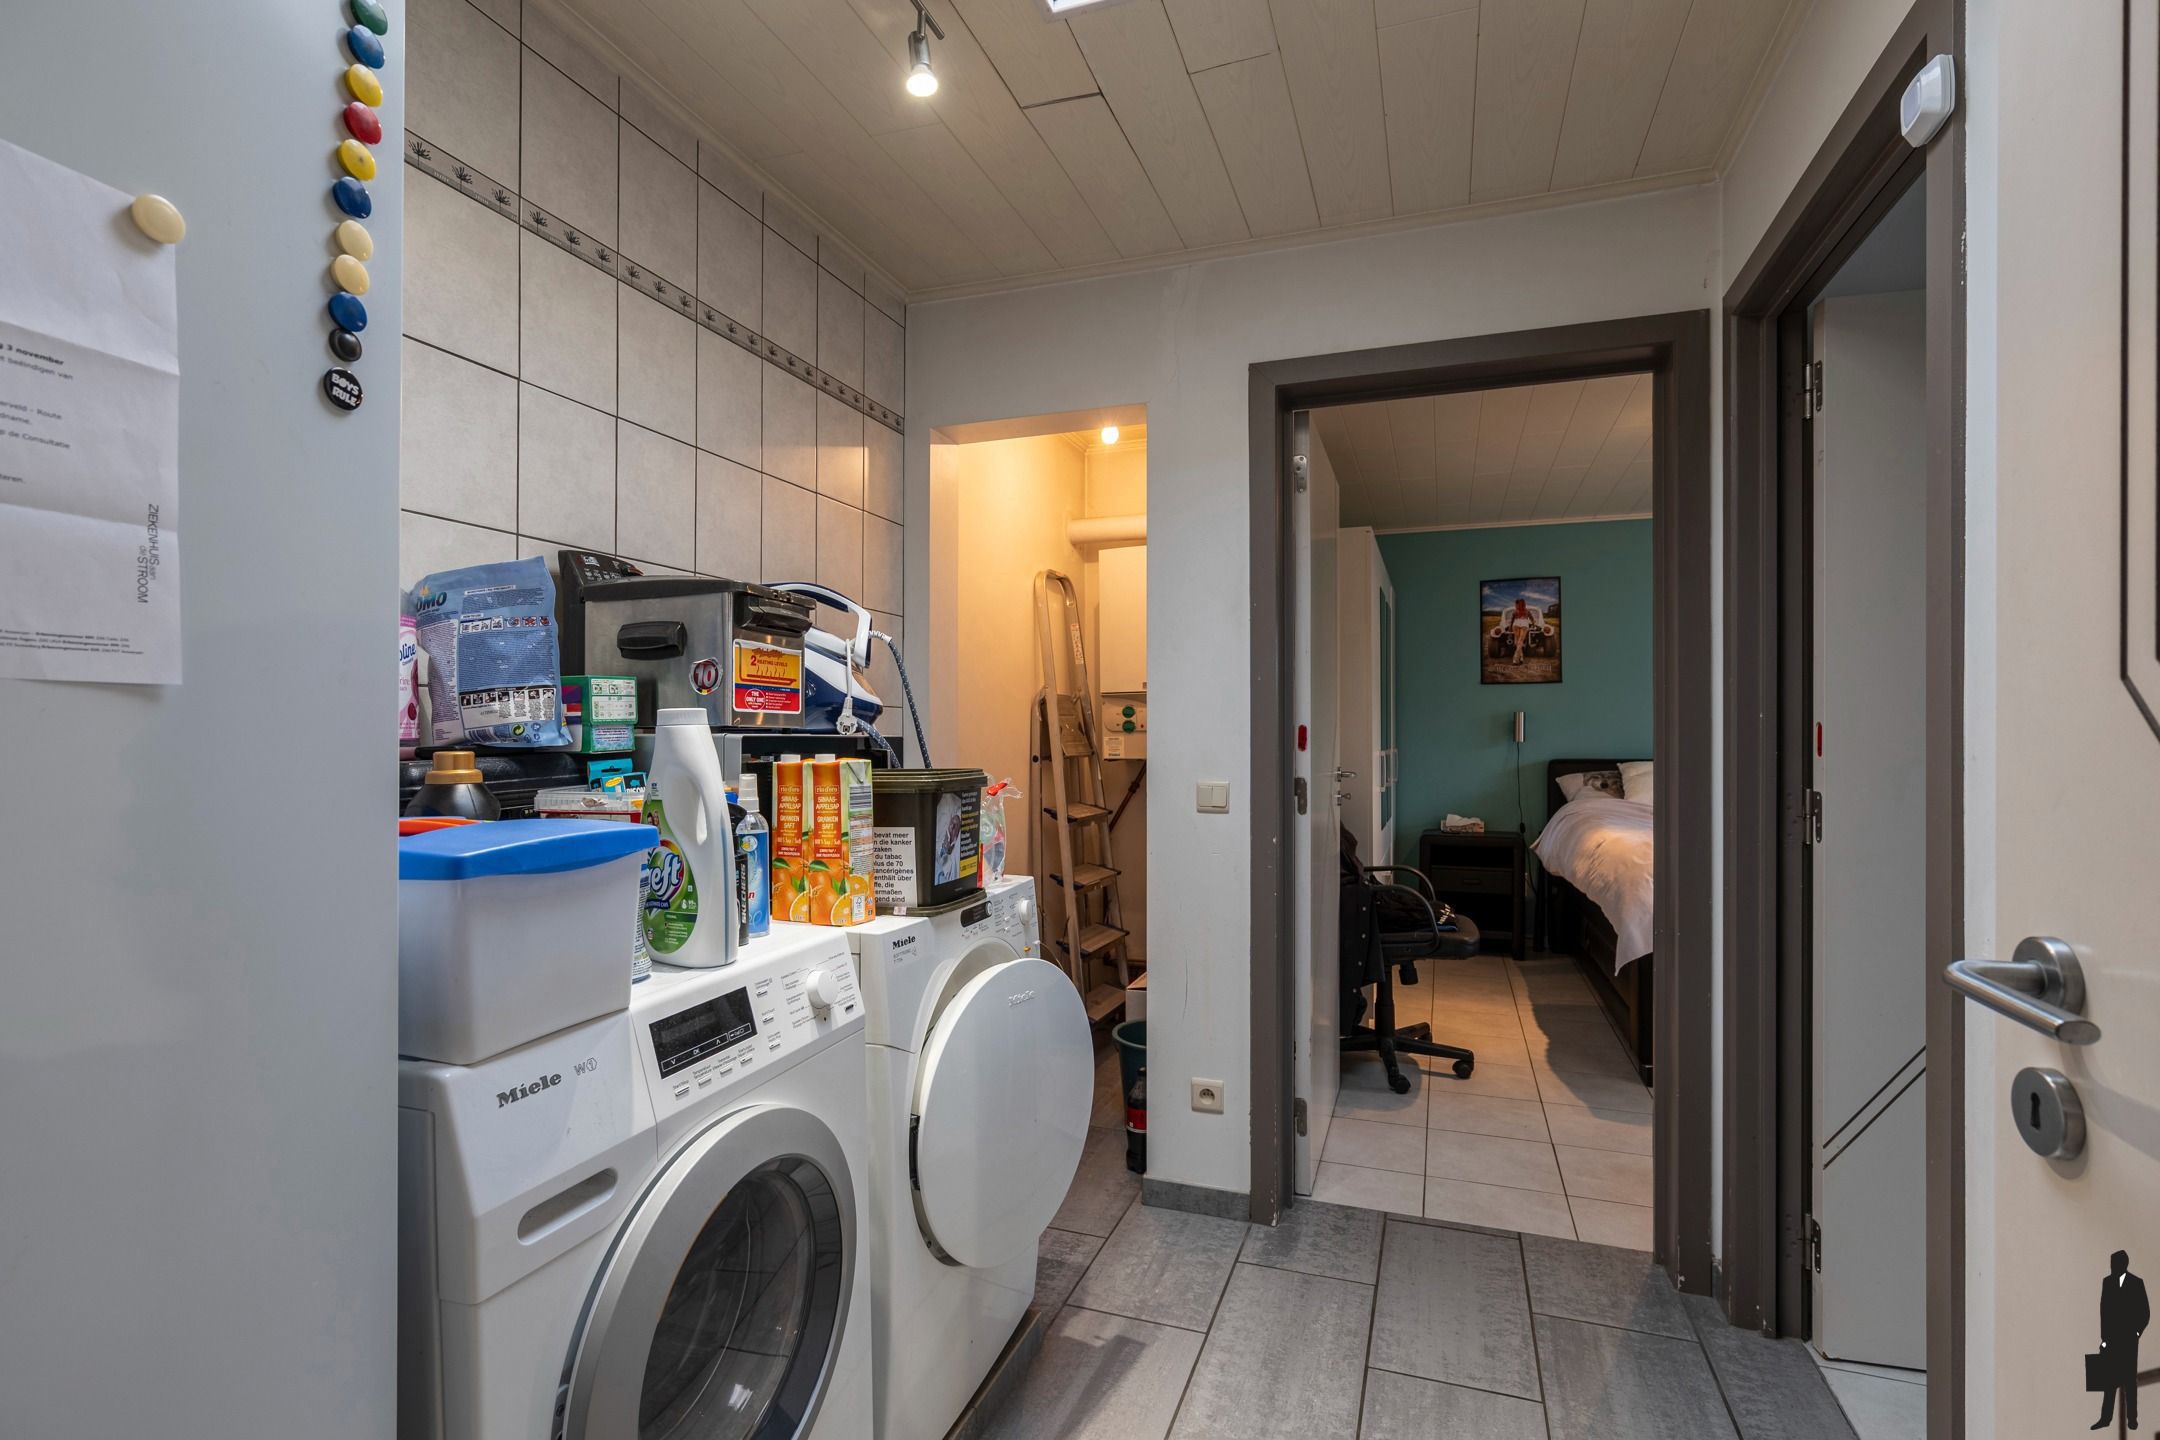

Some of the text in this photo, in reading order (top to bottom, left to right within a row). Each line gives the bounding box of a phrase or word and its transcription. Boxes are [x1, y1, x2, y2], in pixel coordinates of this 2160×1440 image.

[15, 348, 65, 366] november
[331, 373, 359, 395] BOYS
[332, 386, 357, 407] RULE
[22, 433, 71, 449] Consultatie
[147, 503, 160, 566] ZIEKENHUIS
[137, 556, 149, 603] STROOM
[750, 655, 757, 666] 2
[695, 664, 717, 688] 10
[892, 935, 916, 950] Miele
[496, 1073, 562, 1109] Miele
